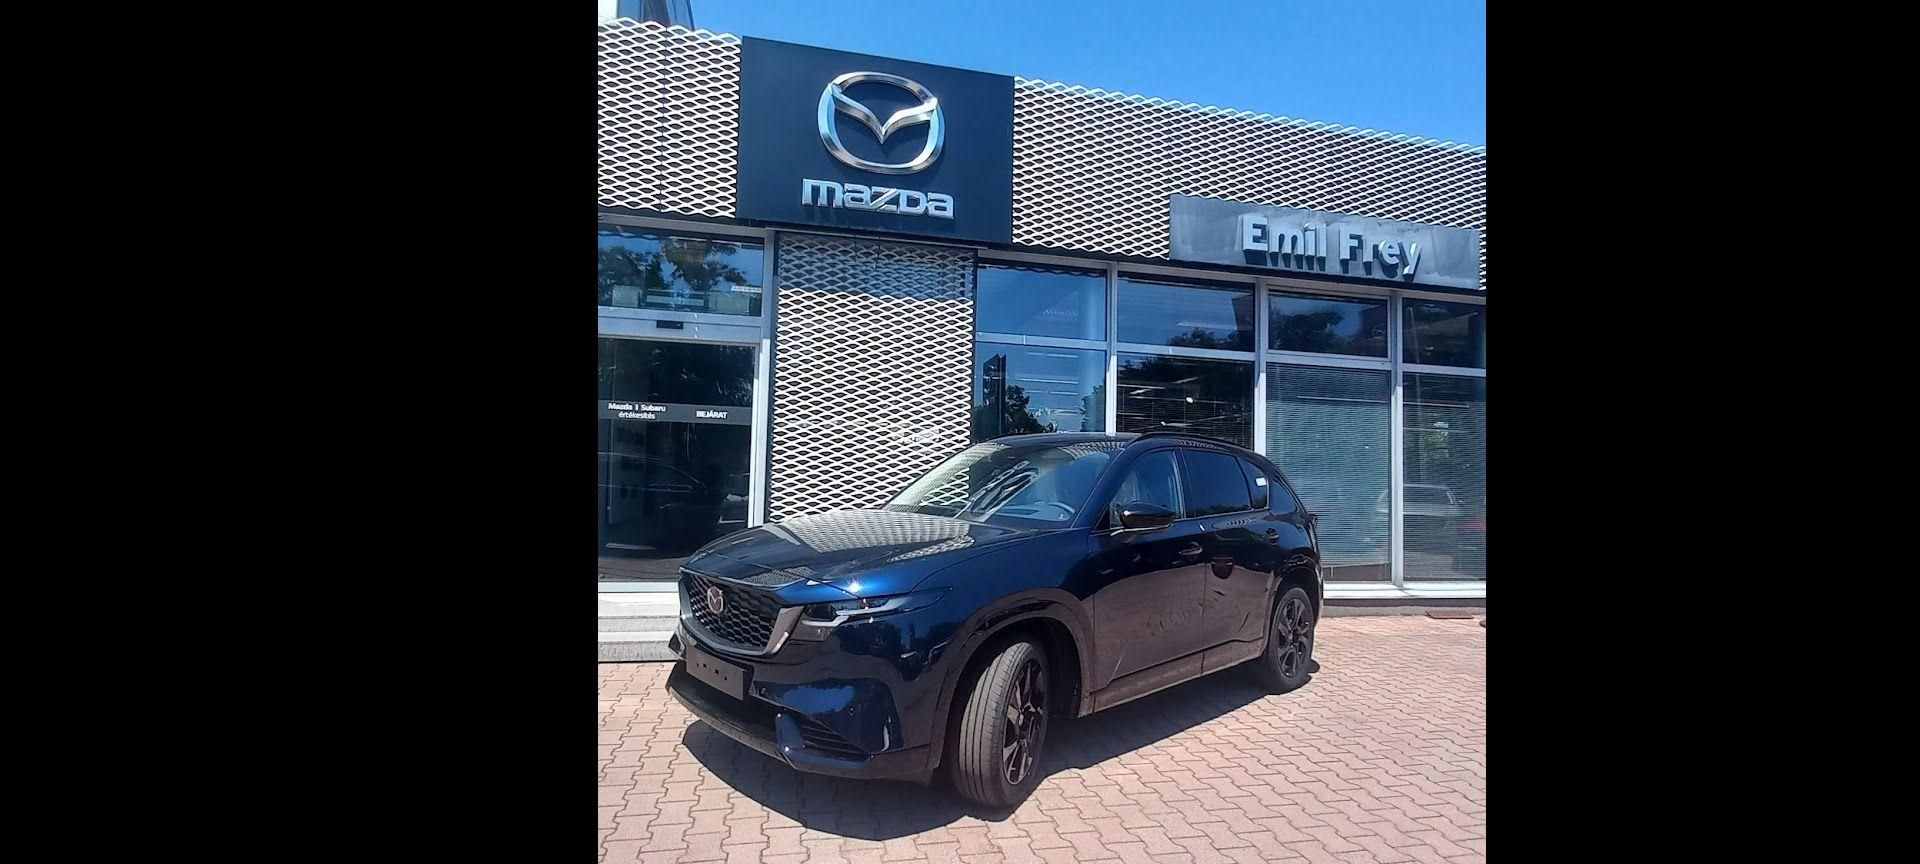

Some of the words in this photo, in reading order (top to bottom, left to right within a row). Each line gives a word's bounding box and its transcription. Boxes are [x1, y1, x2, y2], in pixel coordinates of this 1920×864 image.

[1241, 215, 1327, 257] Emil
[1338, 226, 1423, 275] Frey
[608, 403, 633, 411] Mazda
[640, 404, 667, 412] Subaru
[696, 409, 728, 419] BEJÁRAT
